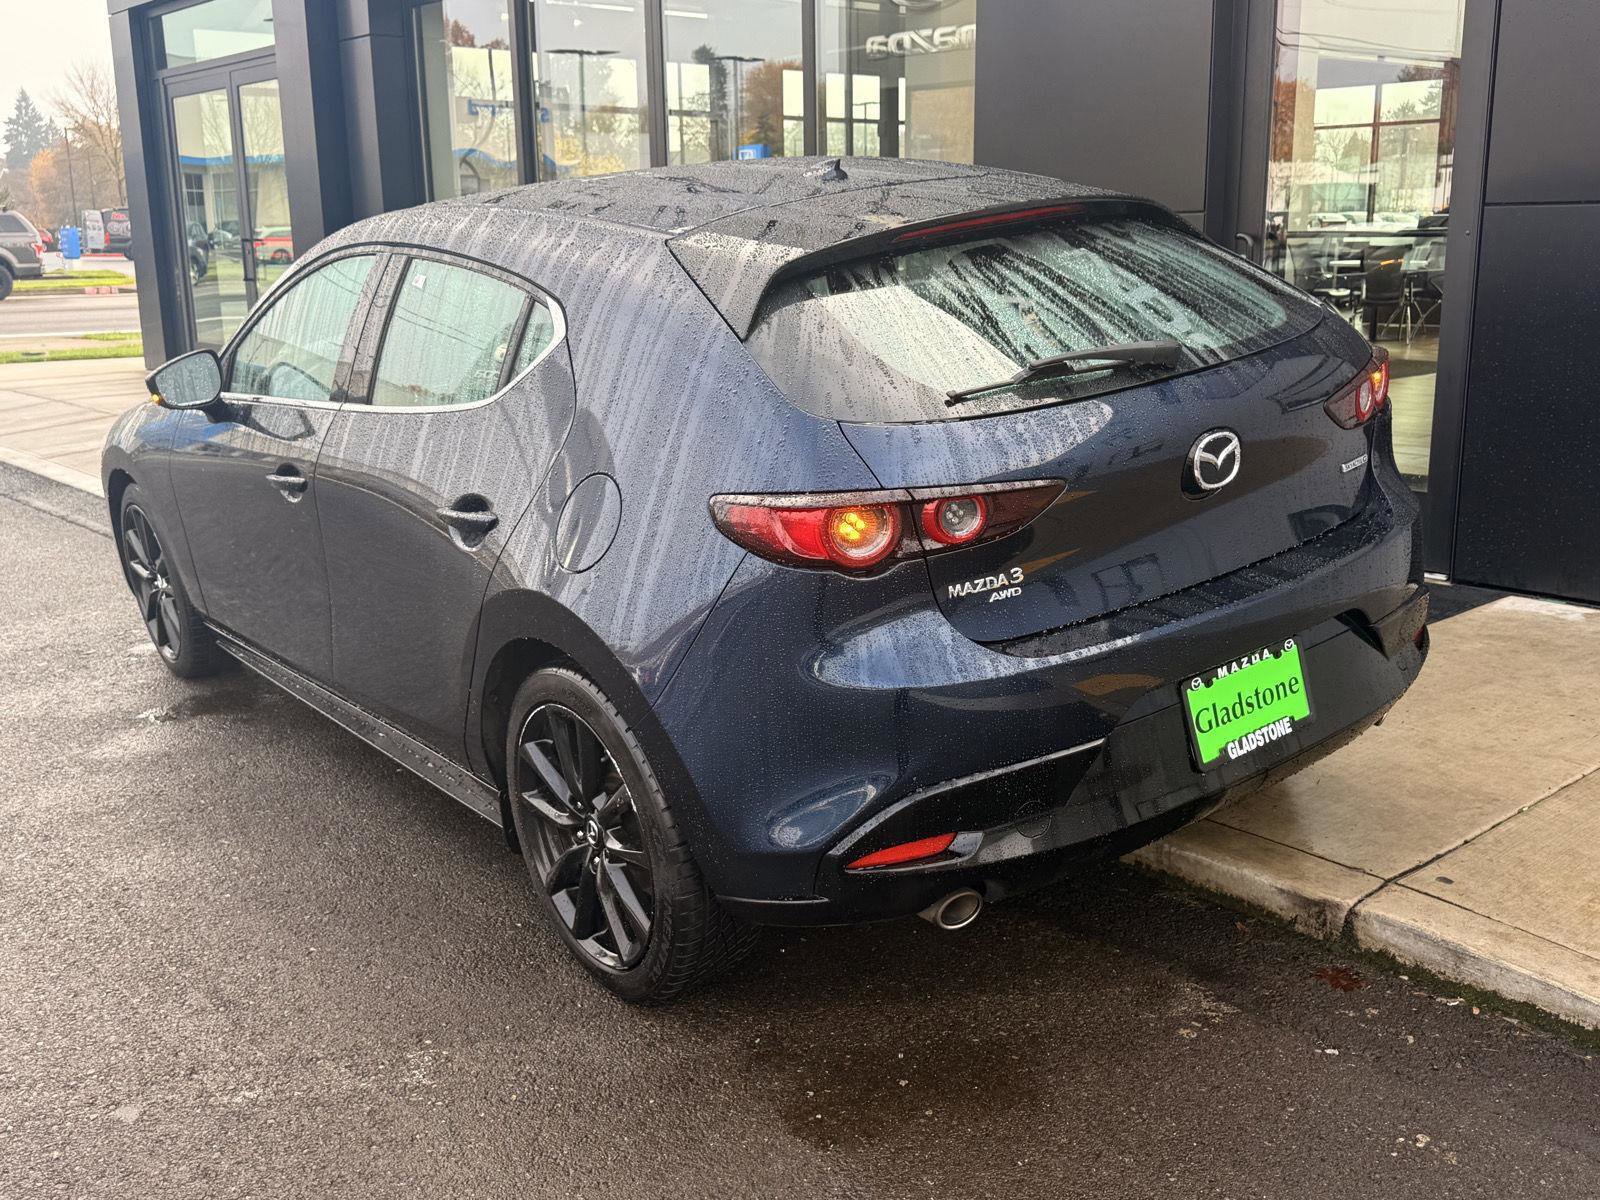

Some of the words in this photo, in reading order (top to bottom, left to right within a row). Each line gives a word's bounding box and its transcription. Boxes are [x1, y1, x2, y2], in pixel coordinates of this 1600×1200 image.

[989, 587, 1022, 602] AWD
[1217, 648, 1271, 678] MAZDA
[1195, 676, 1300, 734] Gladstone
[1227, 717, 1293, 759] GLADSTONE
